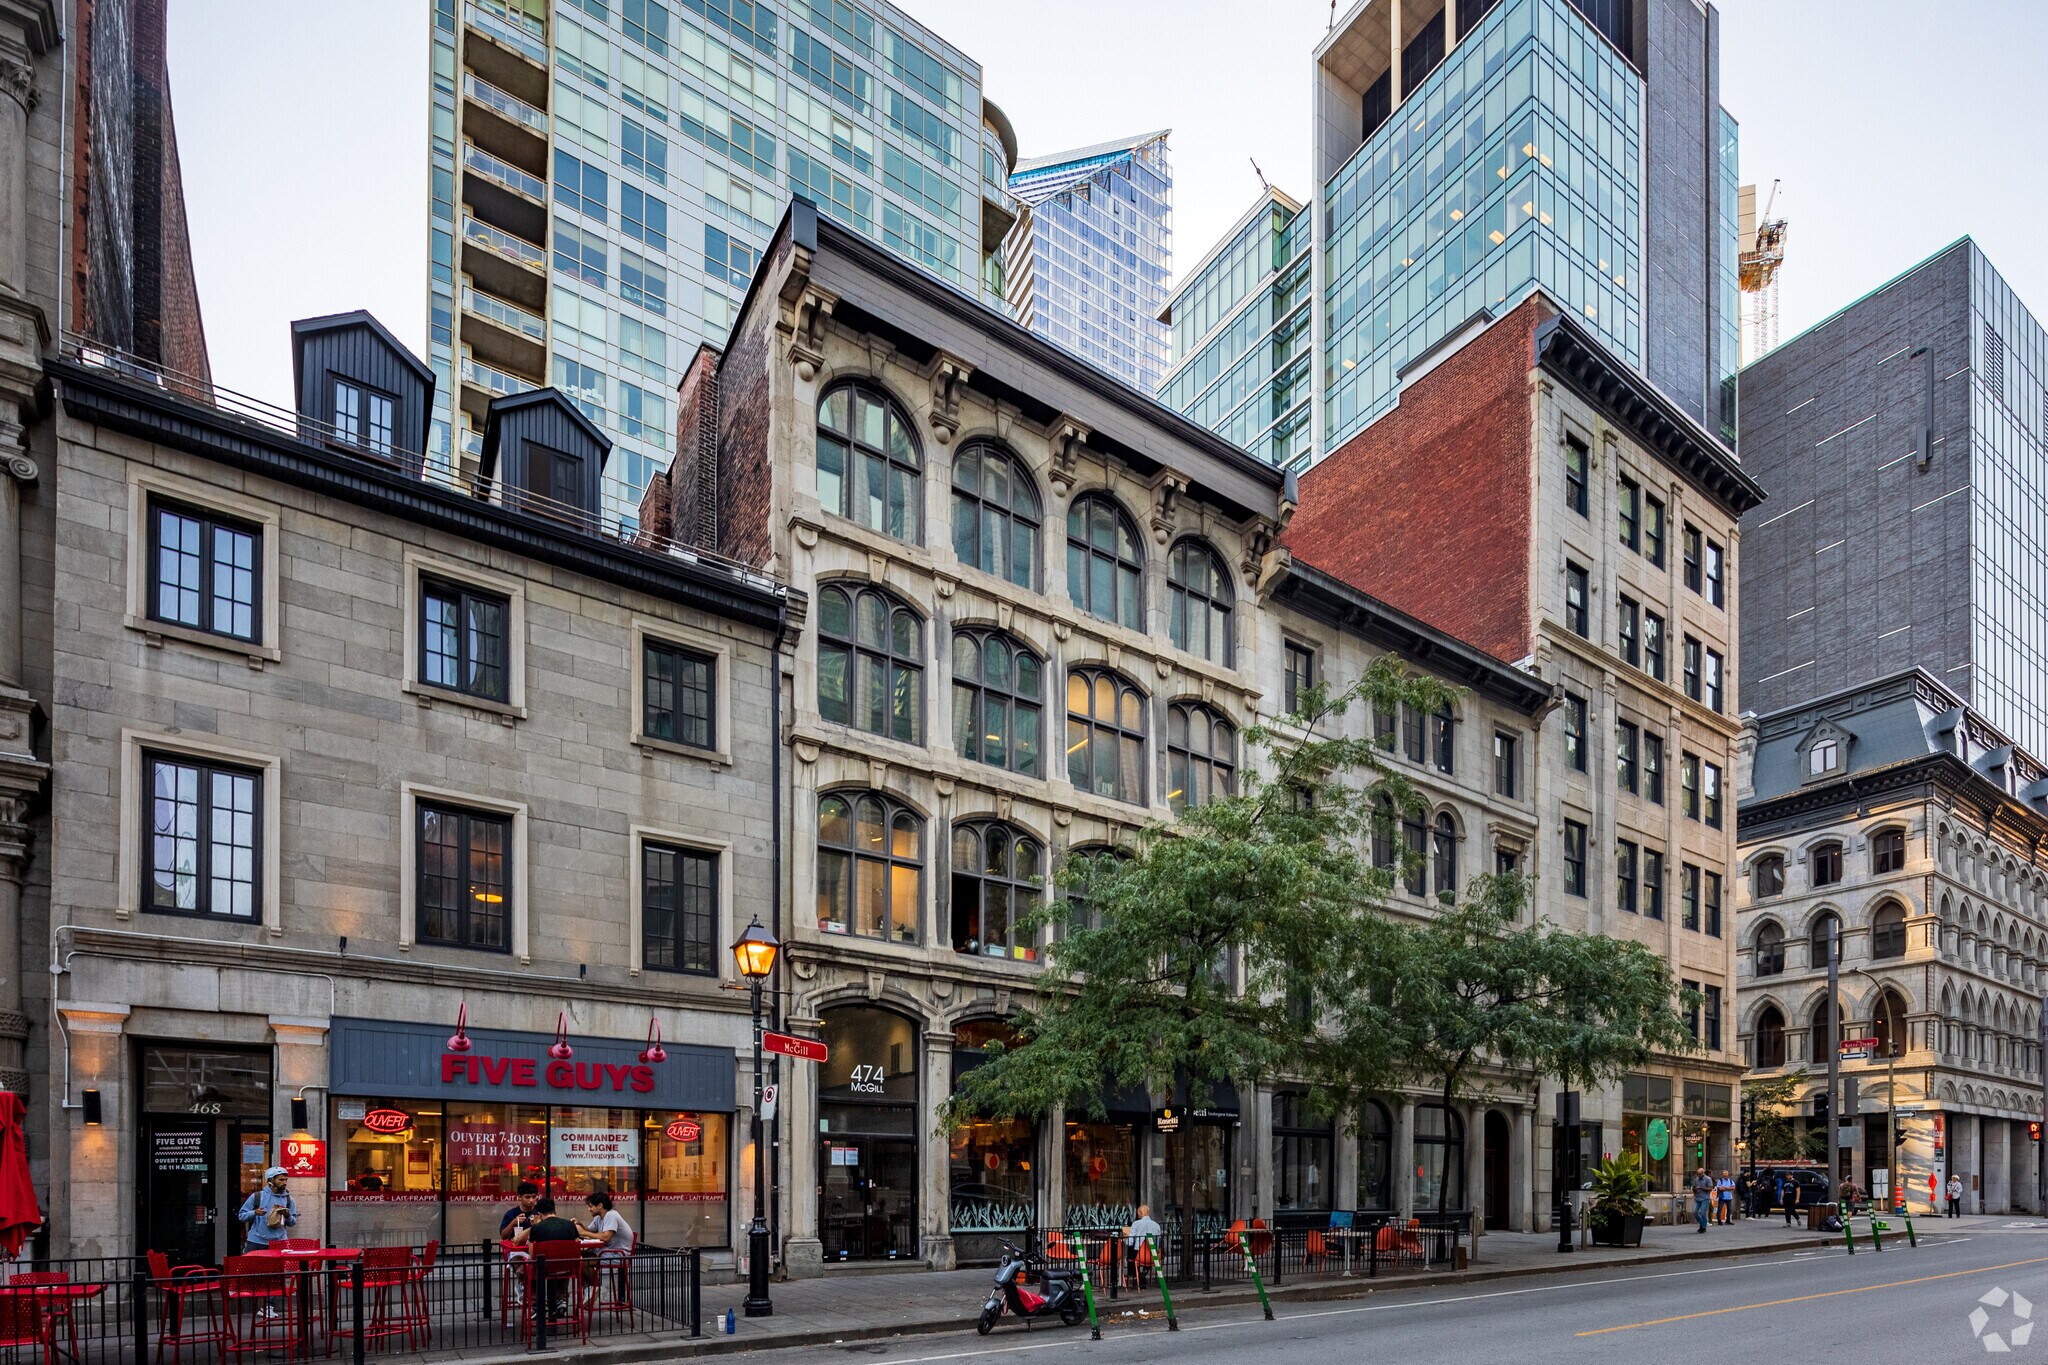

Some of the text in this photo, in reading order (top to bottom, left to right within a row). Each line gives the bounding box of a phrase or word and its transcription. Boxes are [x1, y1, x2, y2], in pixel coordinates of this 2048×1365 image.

[784, 1042, 809, 1056] McGill
[441, 1054, 655, 1093] FIVE GUYS
[850, 1064, 885, 1084] 474
[189, 1103, 221, 1114] 468
[364, 1114, 410, 1127] OUVERT
[1157, 1116, 1179, 1125] Rosetti
[450, 1130, 541, 1144] OUVERT 7 JOURS
[667, 1126, 701, 1137] OUVERT
[177, 1137, 201, 1145] GUYS
[560, 1133, 629, 1142] COMMANDEZ
[461, 1147, 473, 1156] DE
[475, 1144, 486, 1156] 11
[489, 1146, 497, 1156] H
[507, 1144, 520, 1156] 22
[523, 1147, 531, 1157] H
[571, 1143, 619, 1152] EN LIGNE
[565, 1152, 625, 1160] www.fiveguys.ca
[354, 1193, 385, 1202] FRAPPÉ
[409, 1193, 438, 1202] FRAPPÉ
[467, 1193, 494, 1202] FRAPPÉ
